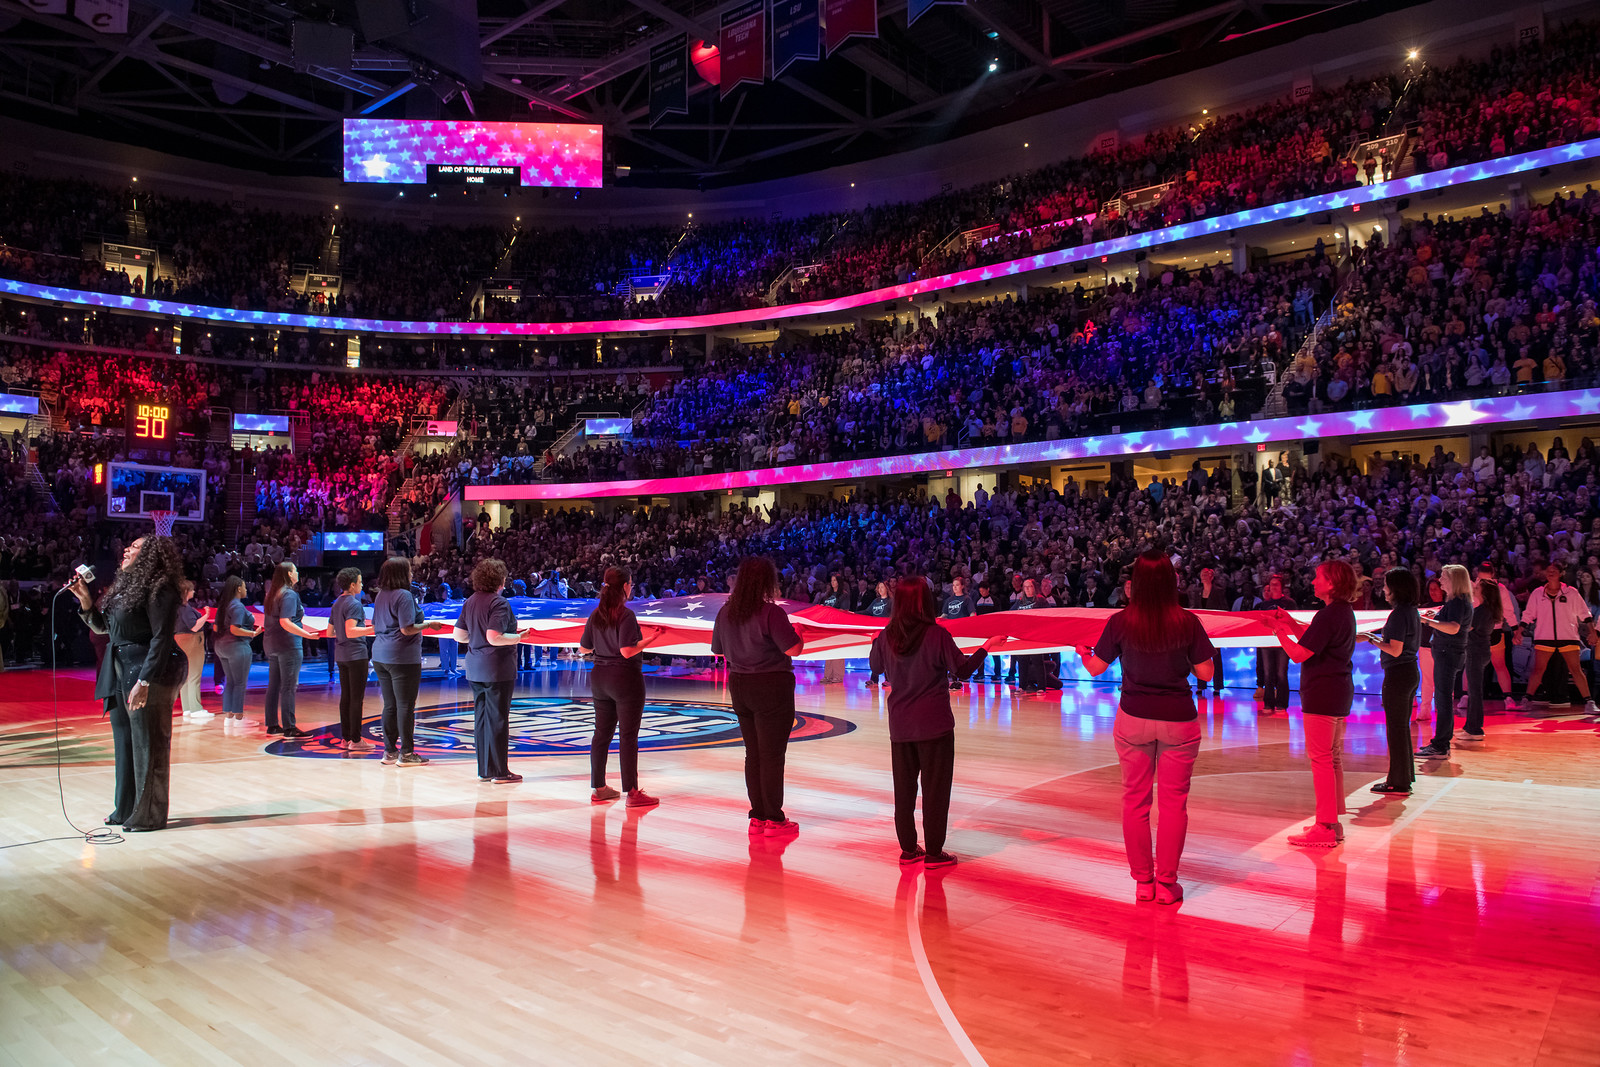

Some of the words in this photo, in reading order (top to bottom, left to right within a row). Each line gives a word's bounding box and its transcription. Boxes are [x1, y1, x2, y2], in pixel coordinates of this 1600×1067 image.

[789, 2, 802, 15] LSU
[727, 18, 757, 39] LOUISIANA
[1520, 27, 1538, 38] 210
[735, 30, 750, 43] TECH
[1296, 86, 1310, 96] 209
[1385, 138, 1399, 146] 210
[438, 165, 453, 173] LAND
[474, 166, 490, 174] FREE
[502, 167, 515, 175] THE
[138, 404, 169, 420] 10:00
[135, 416, 165, 439] 30
